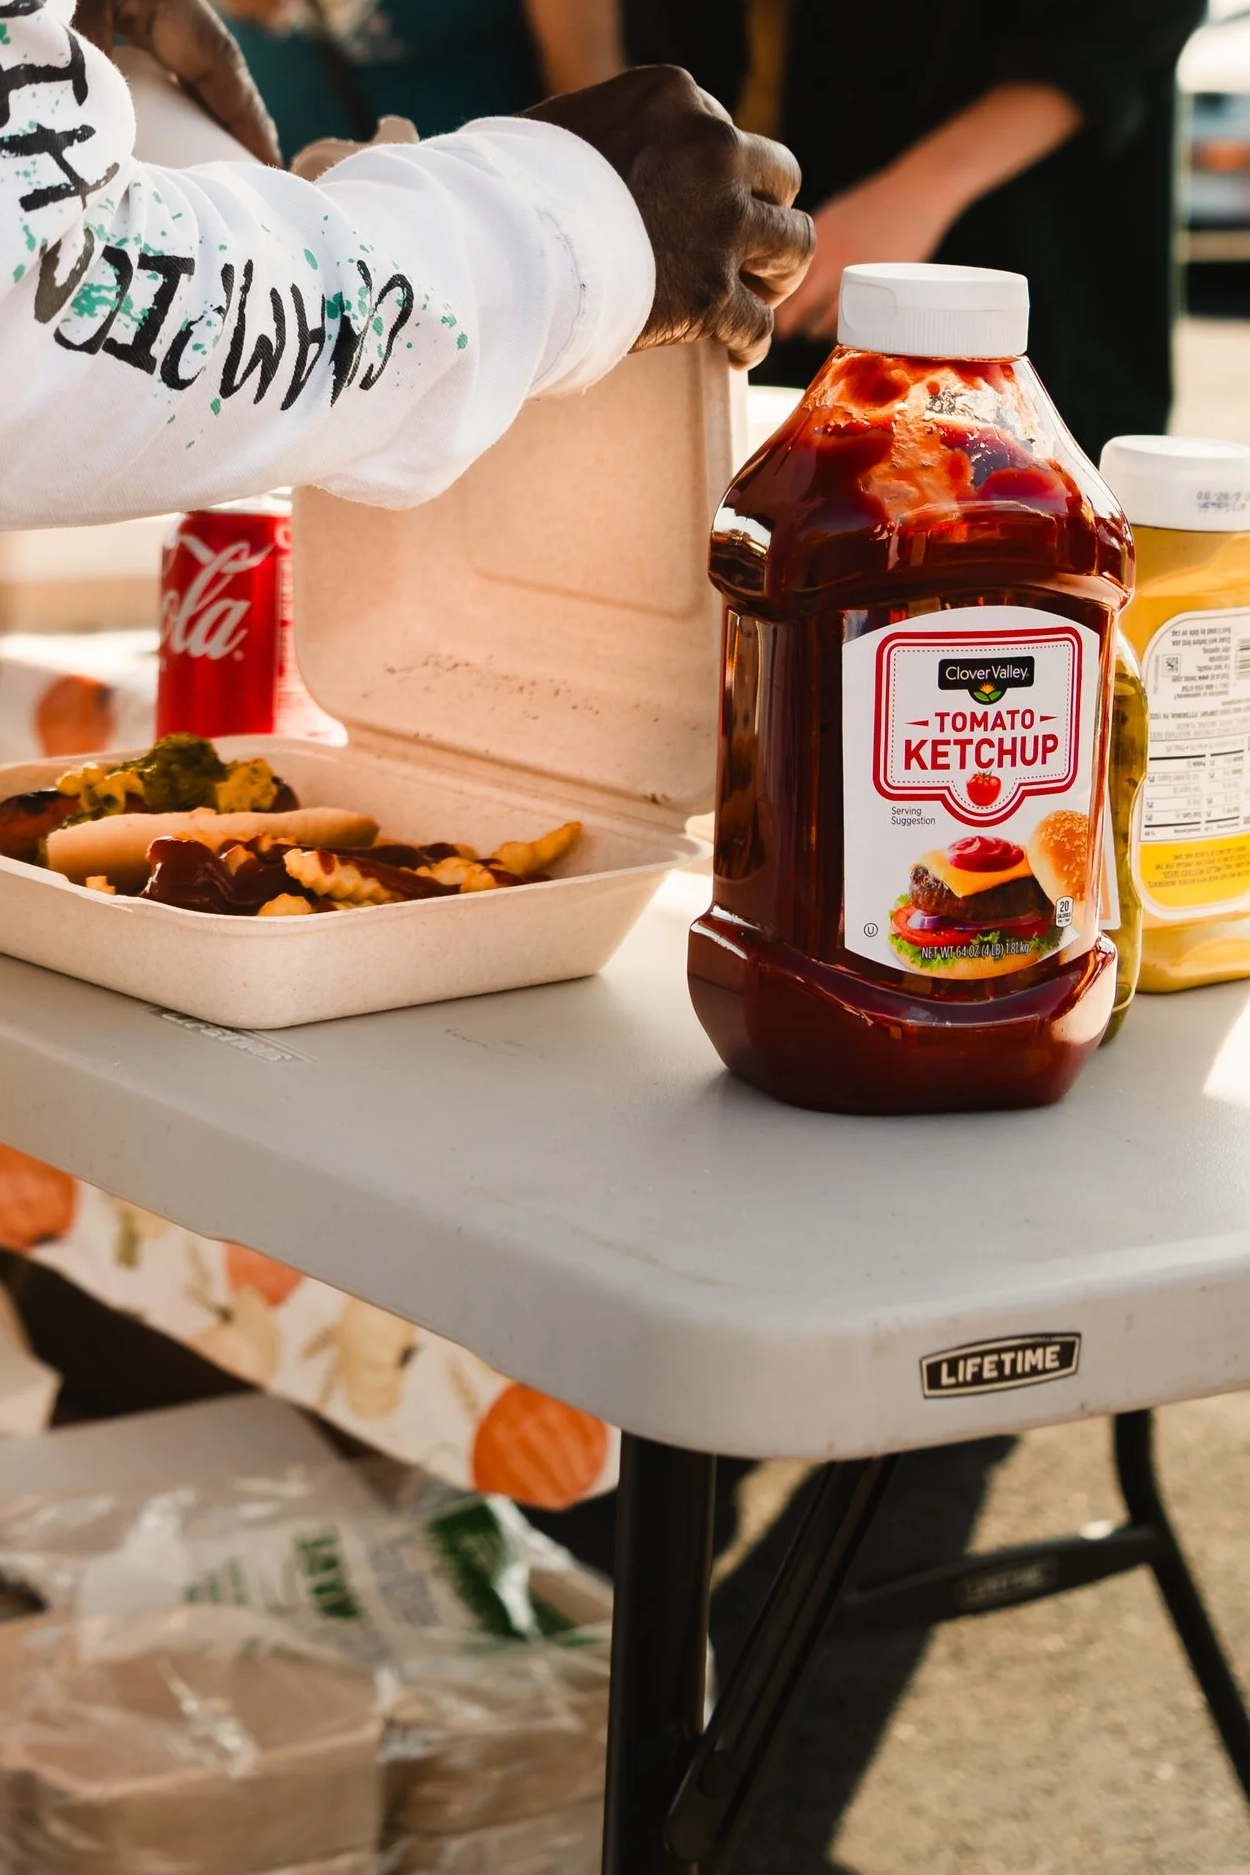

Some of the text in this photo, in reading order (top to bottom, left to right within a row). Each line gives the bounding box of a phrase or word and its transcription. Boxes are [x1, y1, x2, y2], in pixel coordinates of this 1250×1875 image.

[161, 538, 252, 661] ola
[945, 664, 1028, 681] Clover Valley
[934, 708, 1035, 733] TOMATO
[904, 733, 1059, 771] KETCHUP
[891, 806, 922, 817] Serving
[891, 815, 936, 826] Suggestion
[1059, 900, 1070, 913] 20
[921, 946, 938, 959] NET
[940, 946, 953, 958] WT
[955, 945, 967, 958] 64
[968, 945, 980, 957] OZ
[940, 1344, 1061, 1387] LIFETIME
